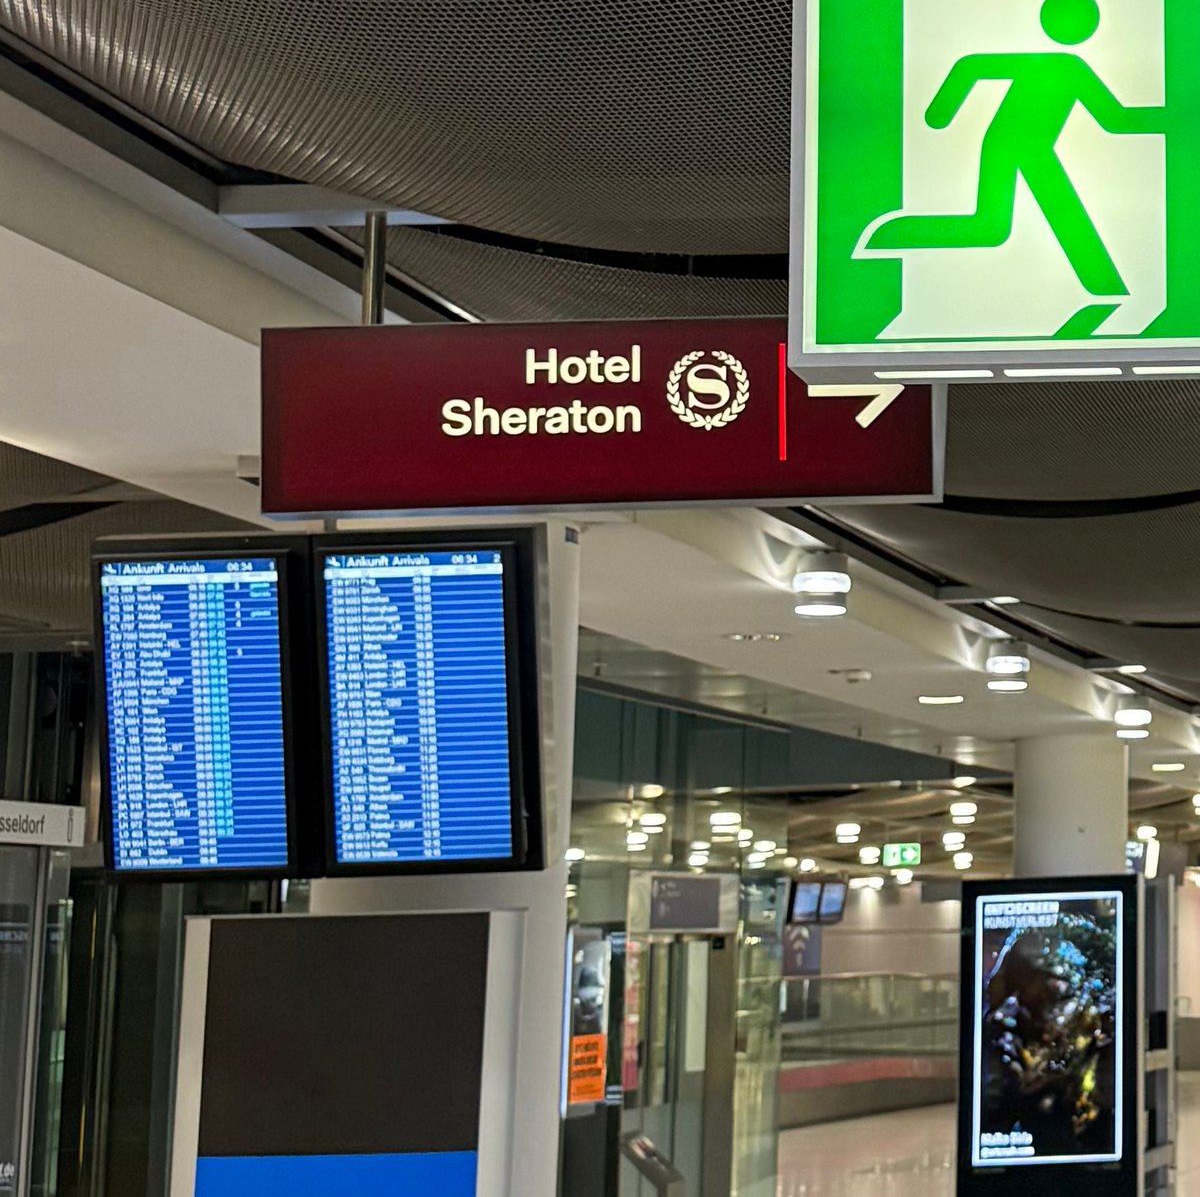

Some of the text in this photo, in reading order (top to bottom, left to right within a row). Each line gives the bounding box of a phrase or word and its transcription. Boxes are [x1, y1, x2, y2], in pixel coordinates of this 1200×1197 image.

[525, 345, 641, 384] Hotel
[441, 397, 642, 437] Sheraton
[123, 562, 164, 575] Ankunft
[168, 561, 206, 574] Arrivals
[347, 555, 389, 568] Ankunft
[392, 554, 430, 567] Arrivals
[0, 814, 45, 834] sseldorf
